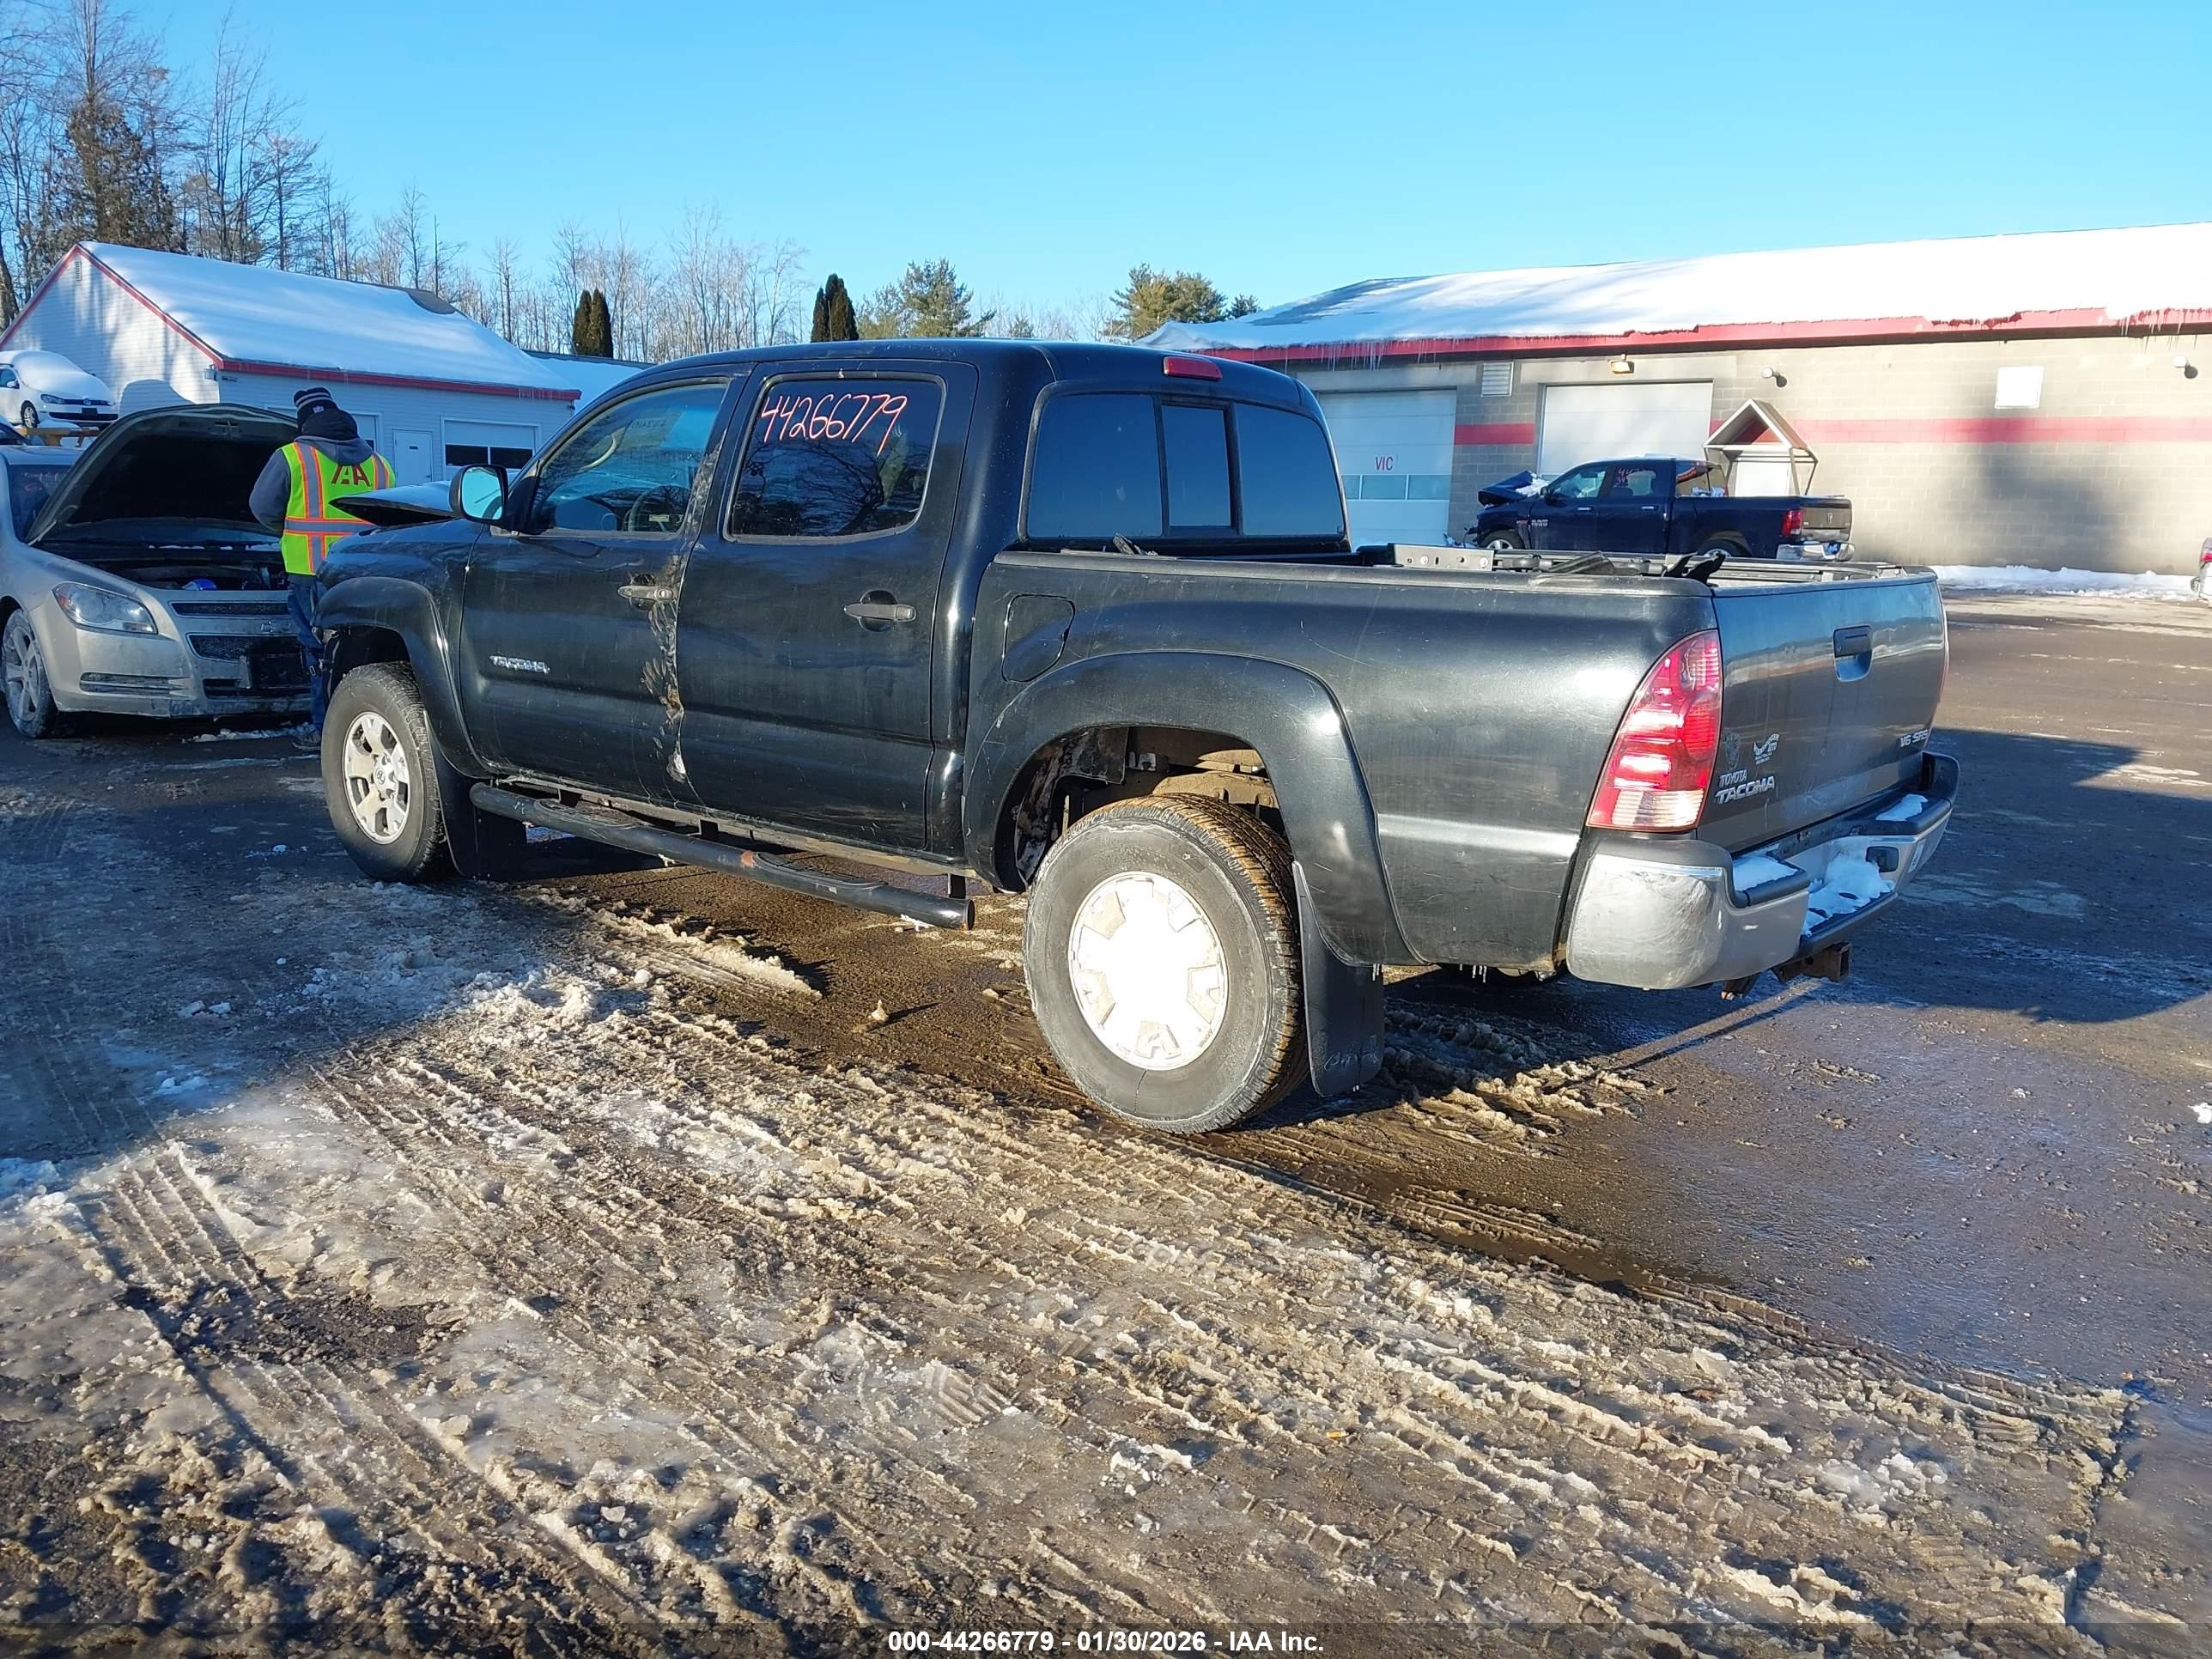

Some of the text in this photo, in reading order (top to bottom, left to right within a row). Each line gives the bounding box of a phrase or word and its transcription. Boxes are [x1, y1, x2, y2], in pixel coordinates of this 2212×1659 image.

[761, 393, 908, 459] 44266779
[1375, 455, 1394, 471] VIC
[489, 655, 550, 674] TACOMA
[1719, 769, 1747, 787] TOYOTA
[1715, 775, 1776, 805] TACOMA
